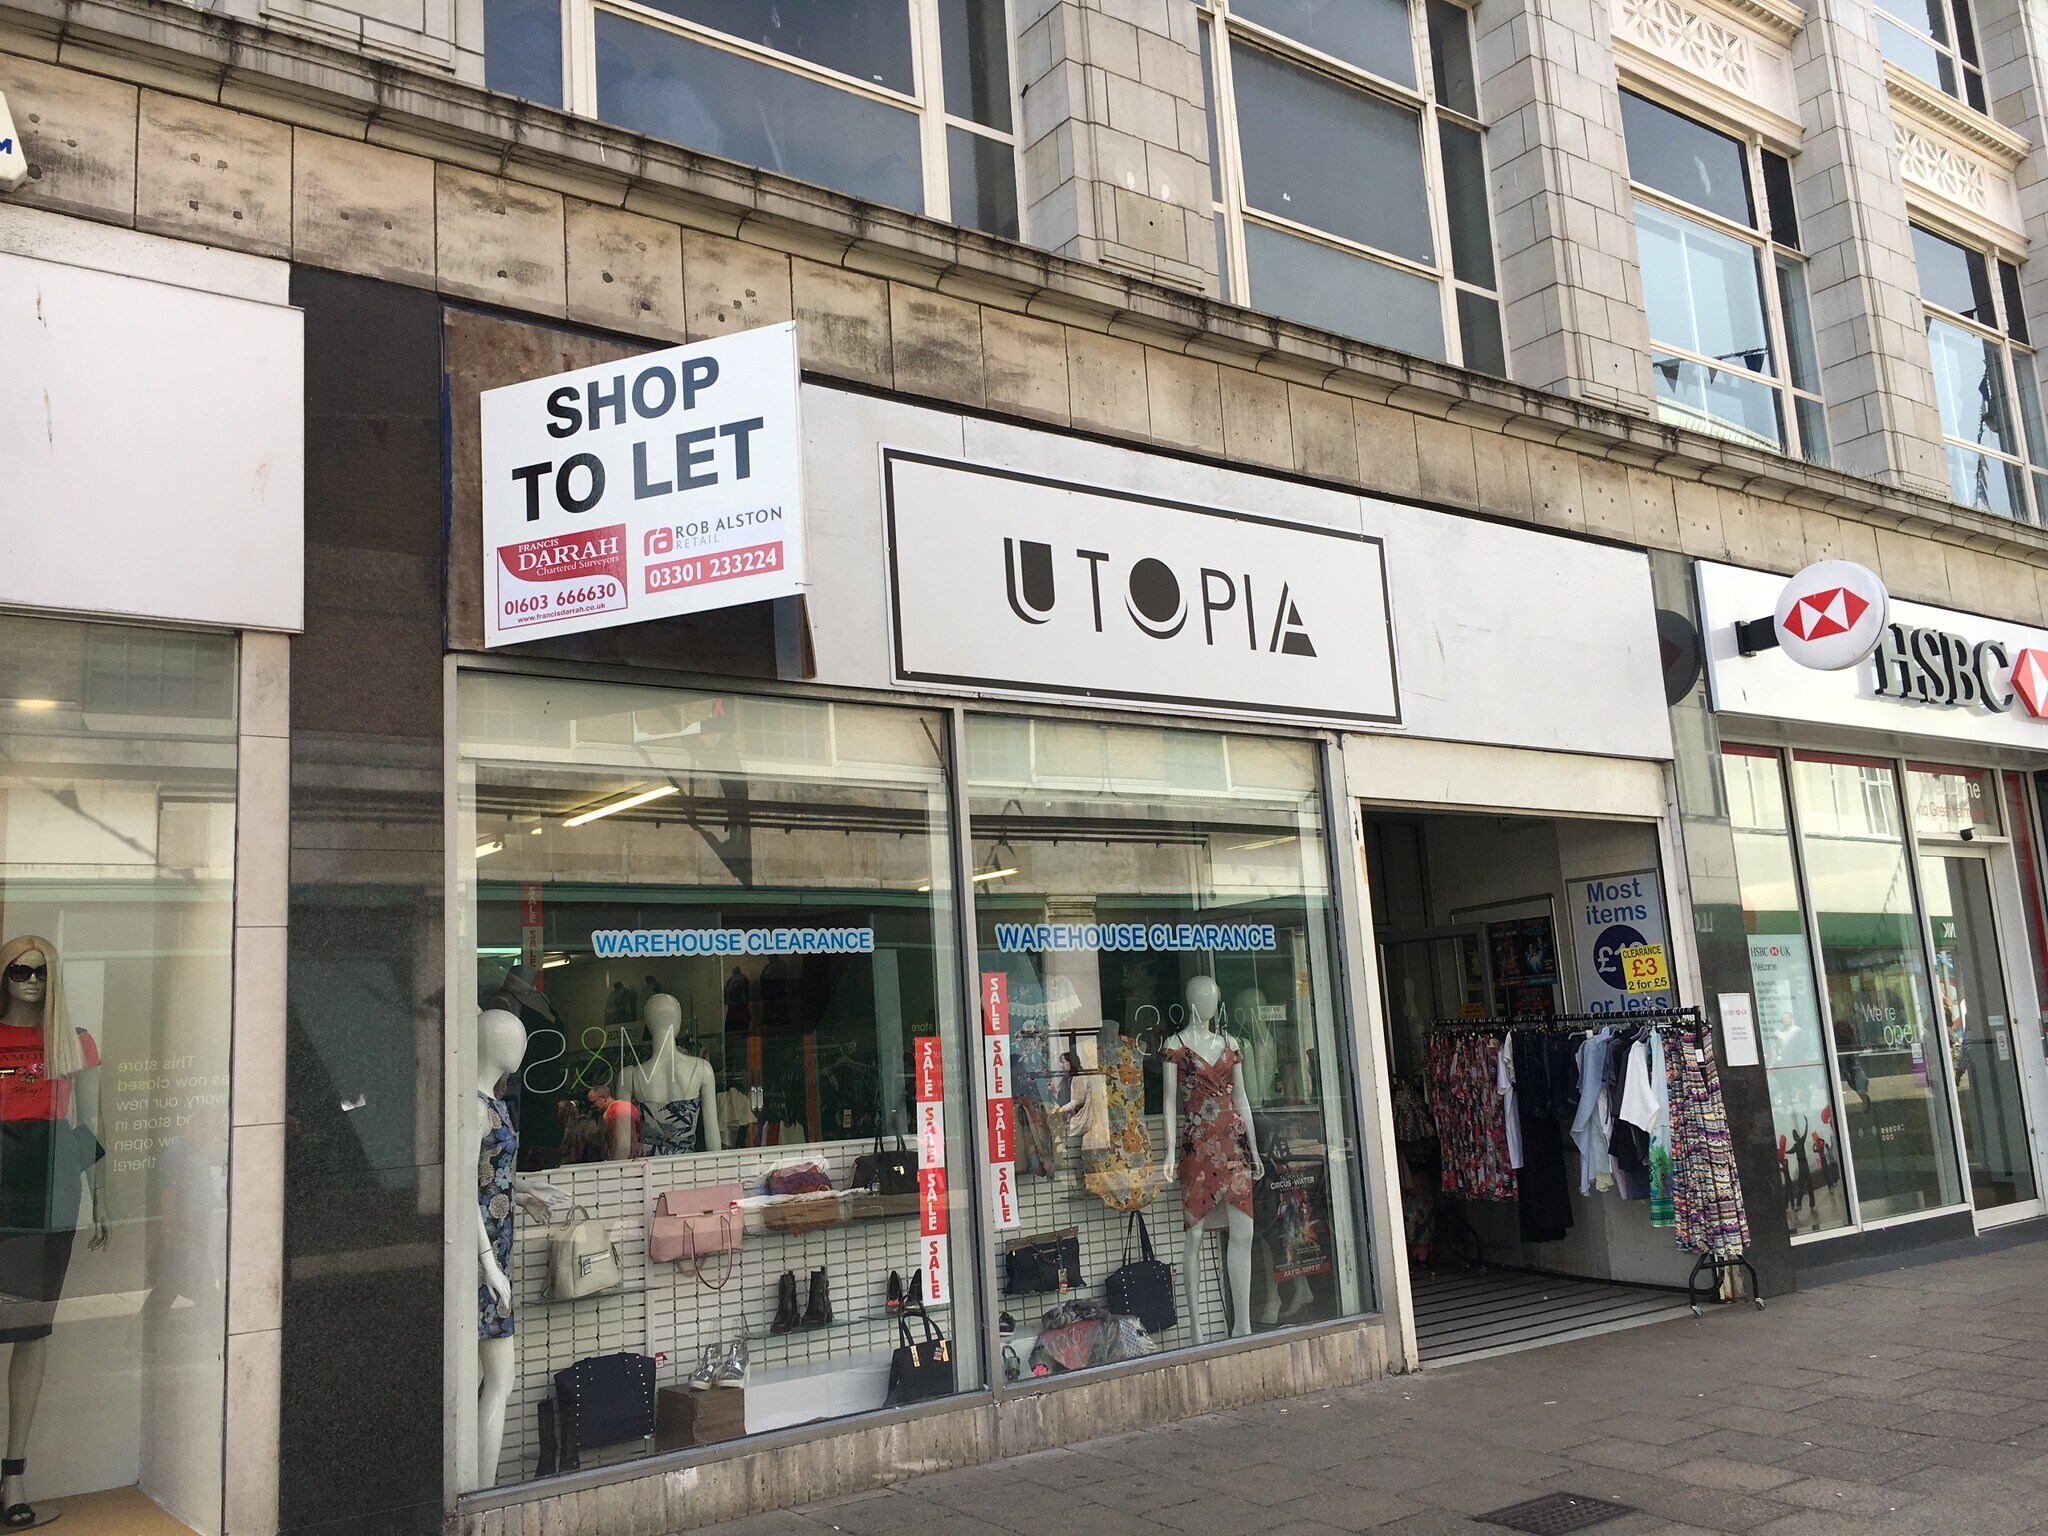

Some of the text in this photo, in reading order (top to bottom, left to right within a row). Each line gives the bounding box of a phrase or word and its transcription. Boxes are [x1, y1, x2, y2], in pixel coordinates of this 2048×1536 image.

[546, 356, 719, 439] SHOP
[512, 416, 764, 522] TO LET
[675, 506, 782, 539] ROB ALSTON
[518, 538, 559, 553] FRANCIS
[518, 536, 619, 571] DARRAH
[676, 533, 720, 550] RETAIL
[536, 555, 620, 577] Chartered Surveyors
[649, 547, 777, 588] 03301 233224
[504, 582, 617, 616] 01603 666630
[517, 602, 606, 624] www.francisdarrah.co.uk
[1003, 537, 1318, 658] UTOPIA
[1874, 623, 2014, 714] HSBC
[1586, 877, 1643, 904] Most
[1585, 904, 1647, 926] items
[595, 931, 872, 954] WAREHOUSE CLEARANCE
[998, 926, 1275, 951] WAREHOUSE CLEARANCE
[1622, 945, 1662, 959] CLEARANCE
[1750, 946, 1791, 957] HSBC UK
[1631, 957, 1658, 978] £3
[1752, 962, 1777, 971] Welcome
[1628, 977, 1667, 991] 2 for £5
[989, 977, 1000, 1032] SALE
[1590, 994, 1669, 1013] or less
[1861, 1002, 1896, 1022] We're
[922, 1042, 934, 1097] SALE
[993, 1039, 1003, 1094] SALE
[925, 1107, 936, 1164] SALE
[995, 1103, 1006, 1158] SALE
[927, 1173, 938, 1231] SALE
[998, 1167, 1011, 1223] SALE
[929, 1241, 940, 1299] SALE
